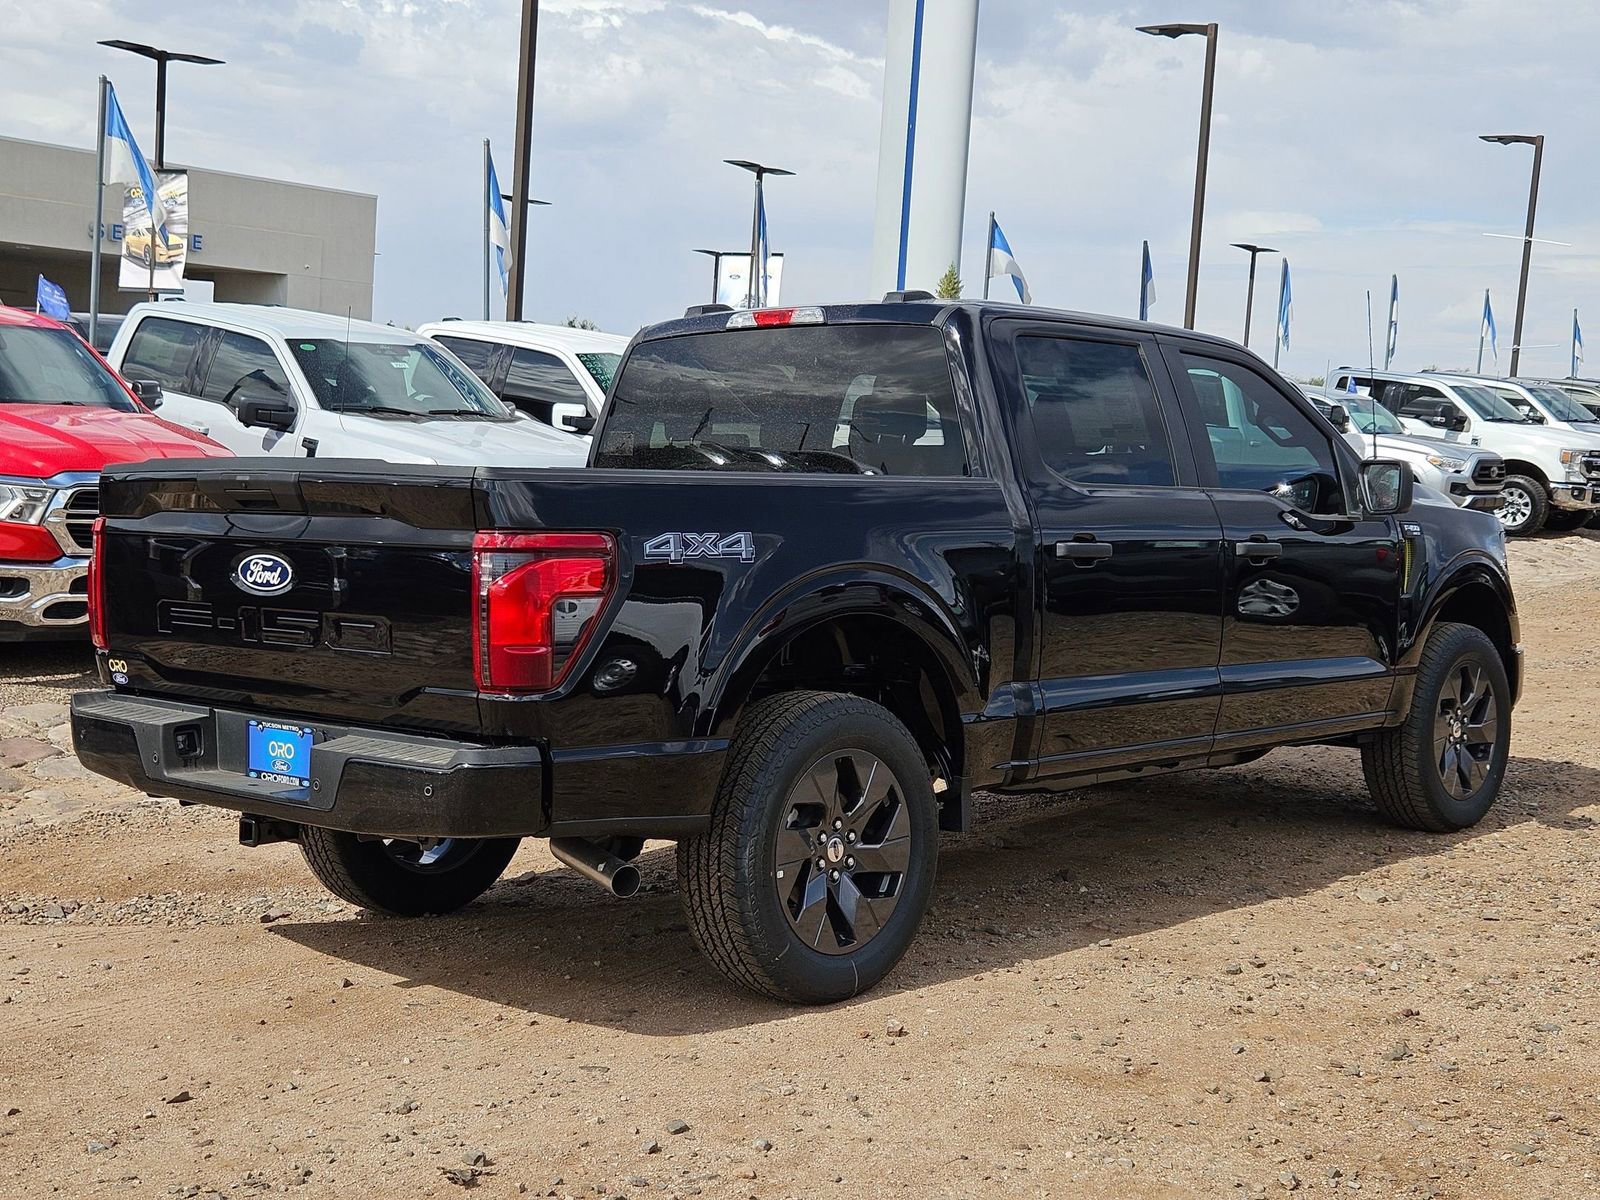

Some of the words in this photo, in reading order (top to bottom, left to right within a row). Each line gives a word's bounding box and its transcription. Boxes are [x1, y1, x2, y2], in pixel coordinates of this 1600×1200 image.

[131, 188, 144, 198] OR
[246, 558, 283, 585] Ford
[157, 598, 393, 655] F-150
[109, 659, 128, 673] ORO
[262, 721, 281, 729] TUCSON
[282, 723, 300, 732] METRO
[269, 741, 295, 759] ORO
[272, 760, 289, 772] Ford
